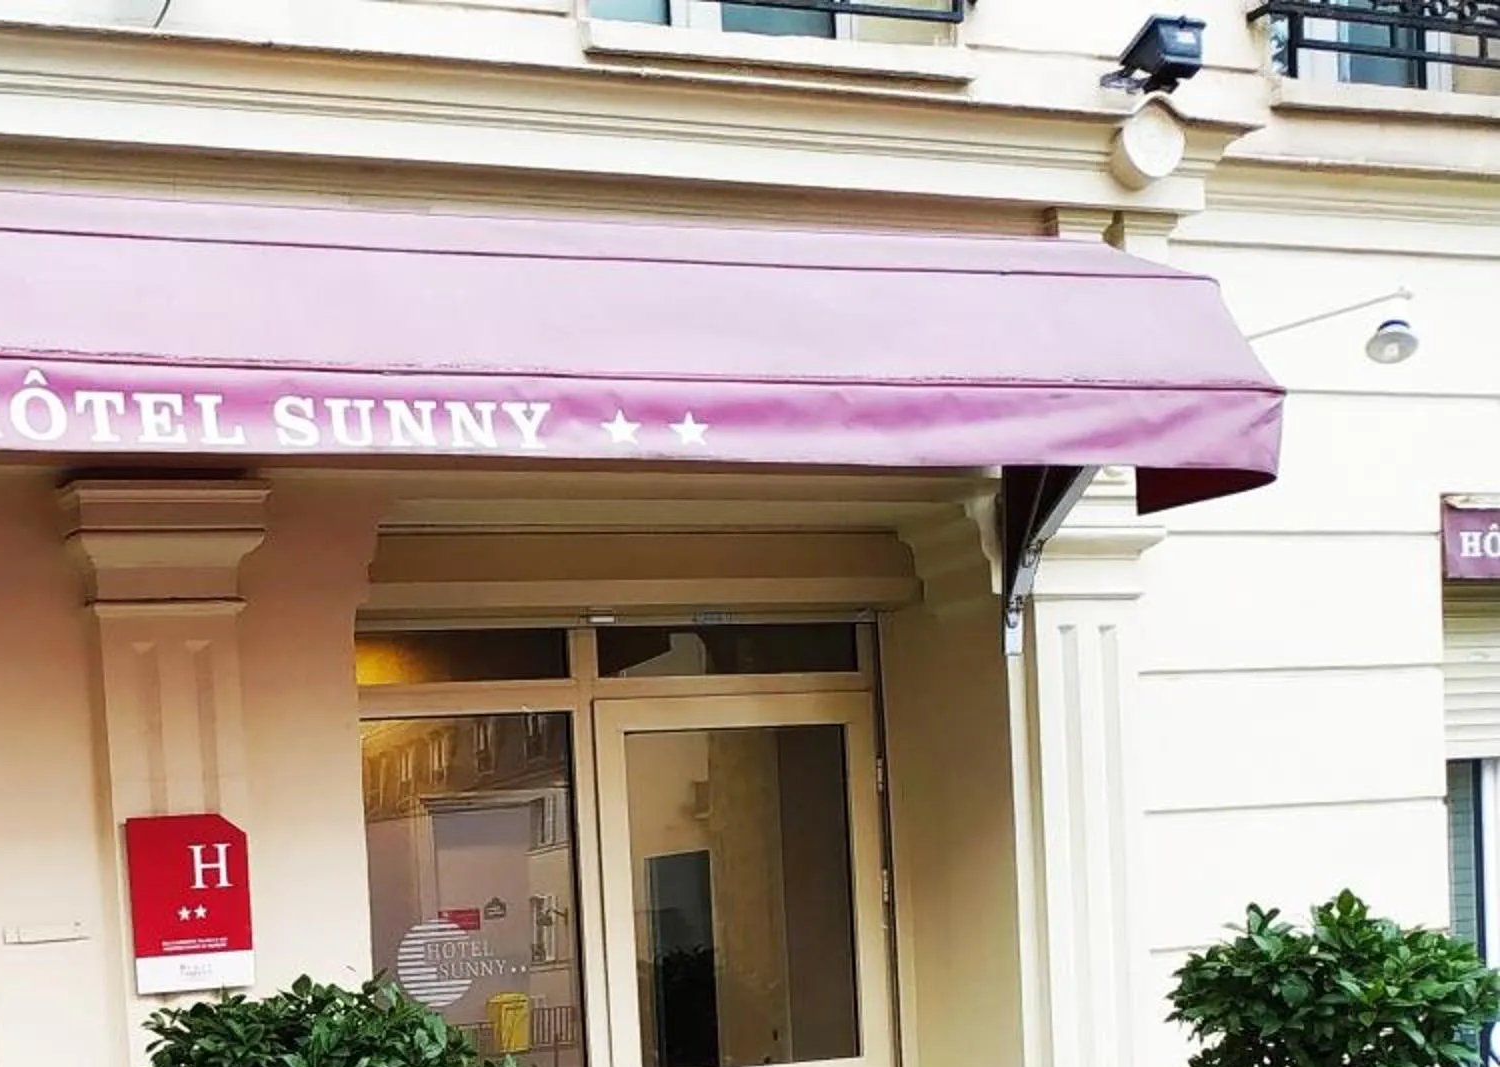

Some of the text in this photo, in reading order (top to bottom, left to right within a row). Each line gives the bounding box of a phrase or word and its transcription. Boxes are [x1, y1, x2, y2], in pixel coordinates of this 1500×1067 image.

[272, 395, 552, 450] SUNNY
[188, 842, 234, 890] H
[425, 941, 495, 960] HOTEL
[437, 960, 507, 979] SUNNY
